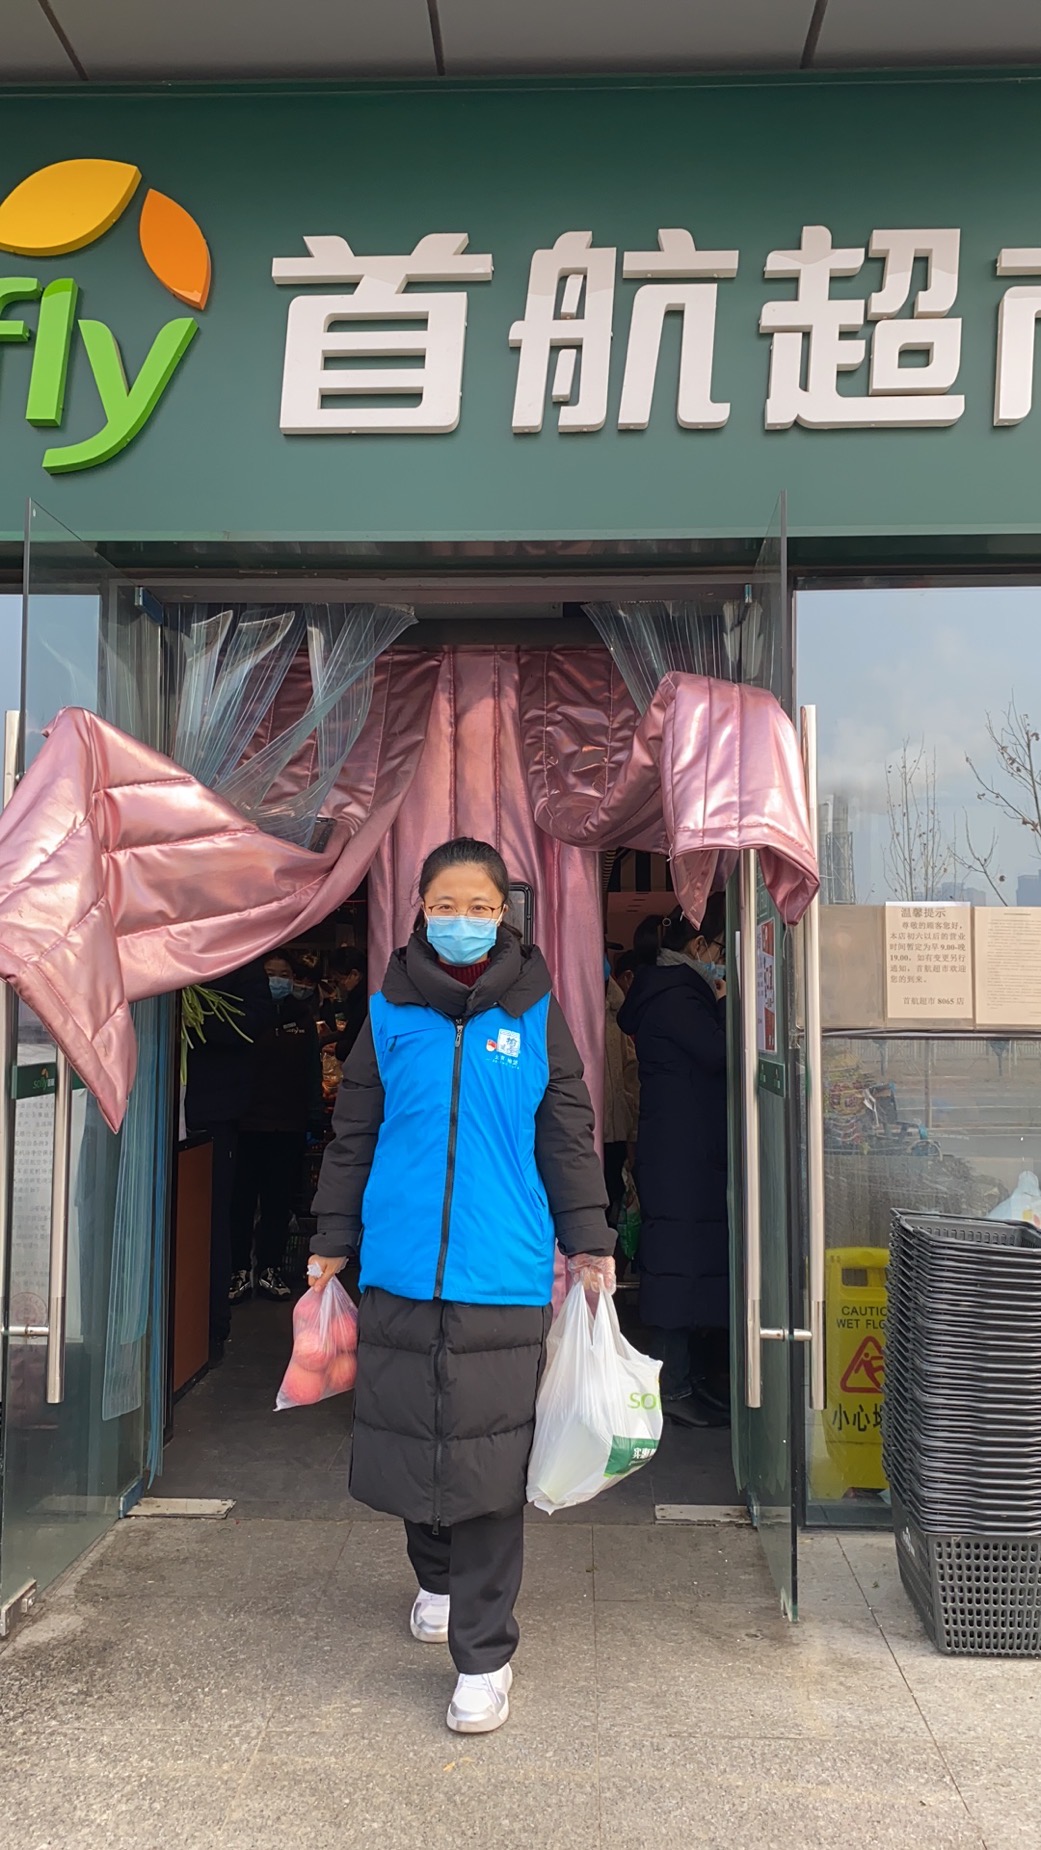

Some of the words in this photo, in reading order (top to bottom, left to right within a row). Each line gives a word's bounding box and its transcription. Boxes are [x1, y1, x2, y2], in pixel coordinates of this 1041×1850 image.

[271, 226, 1041, 435] 首航超
[901, 907, 946, 918] 温馨提示
[890, 932, 966, 941] 本店初六以后的营业
[836, 1318, 860, 1329] WET
